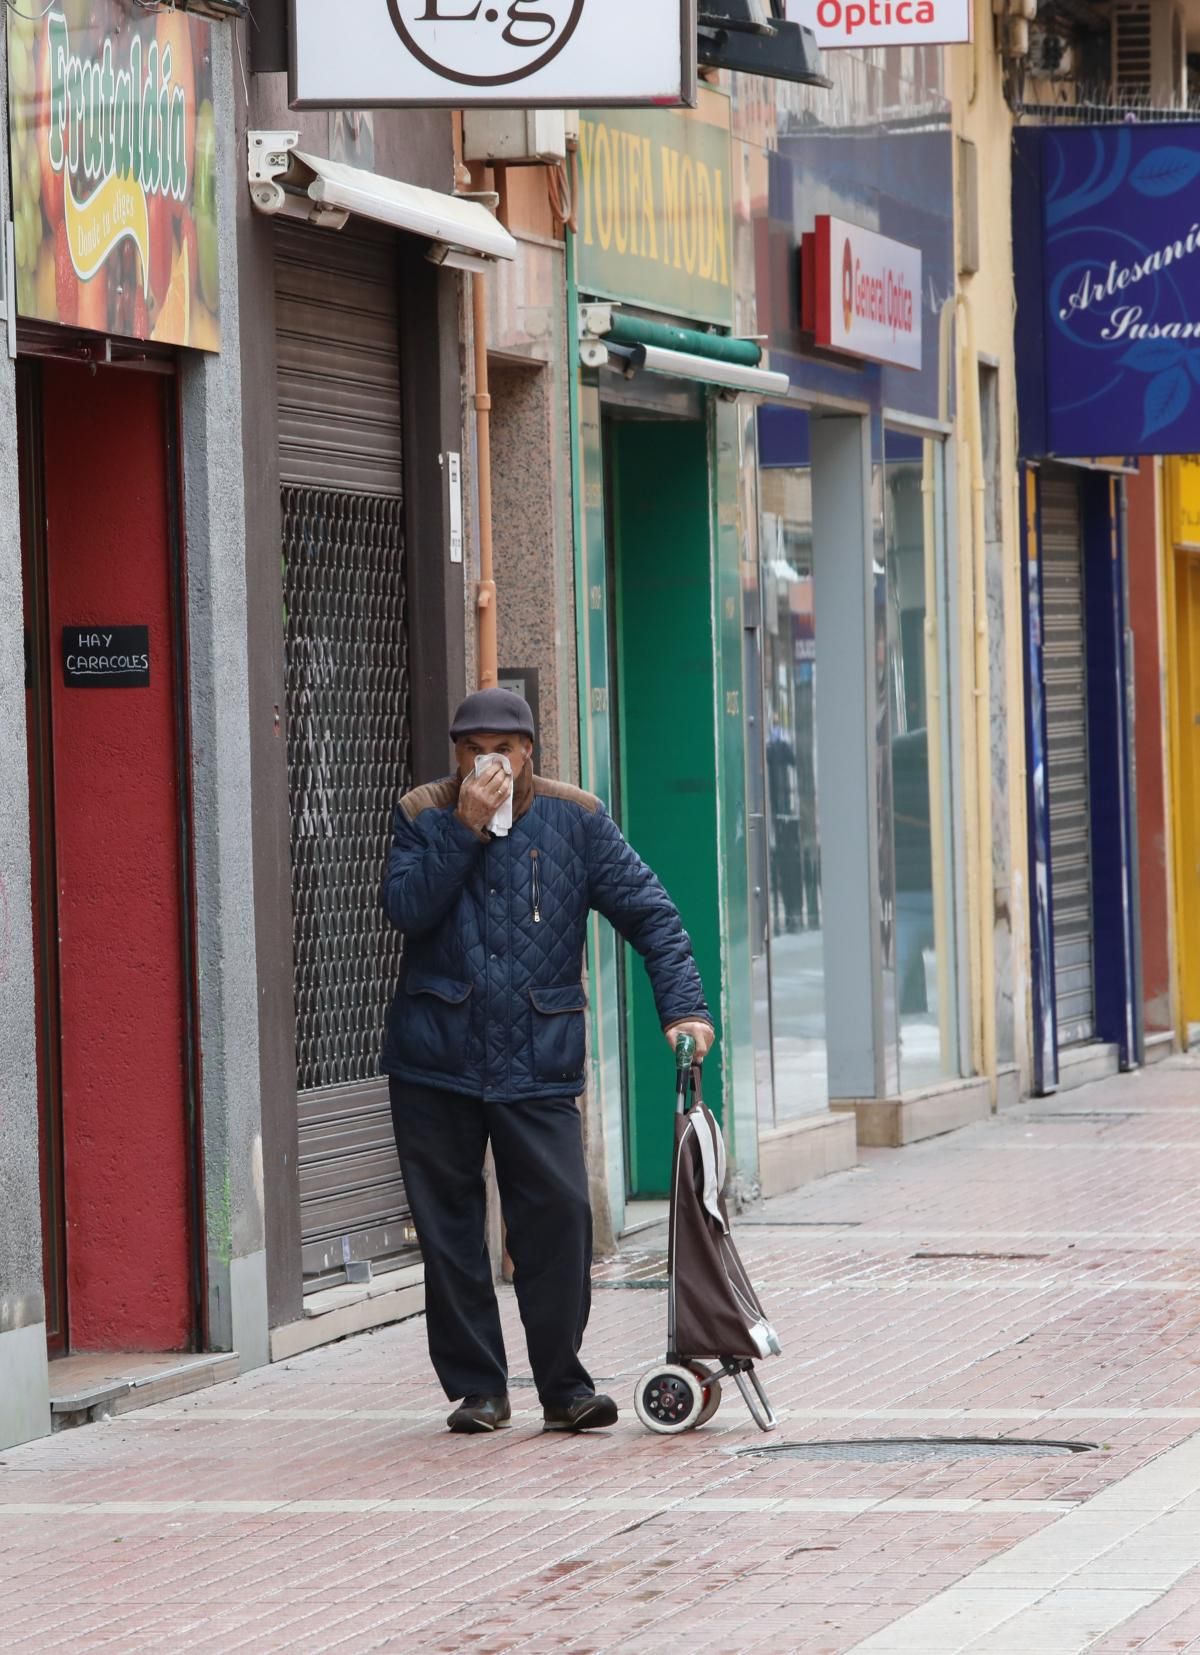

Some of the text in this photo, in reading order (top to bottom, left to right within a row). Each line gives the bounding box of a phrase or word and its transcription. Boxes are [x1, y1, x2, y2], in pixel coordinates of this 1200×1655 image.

[661, 145, 729, 287] MODA
[856, 256, 912, 344] General Optica
[66, 654, 149, 671] CARACOLES
[78, 633, 112, 648] HAY
